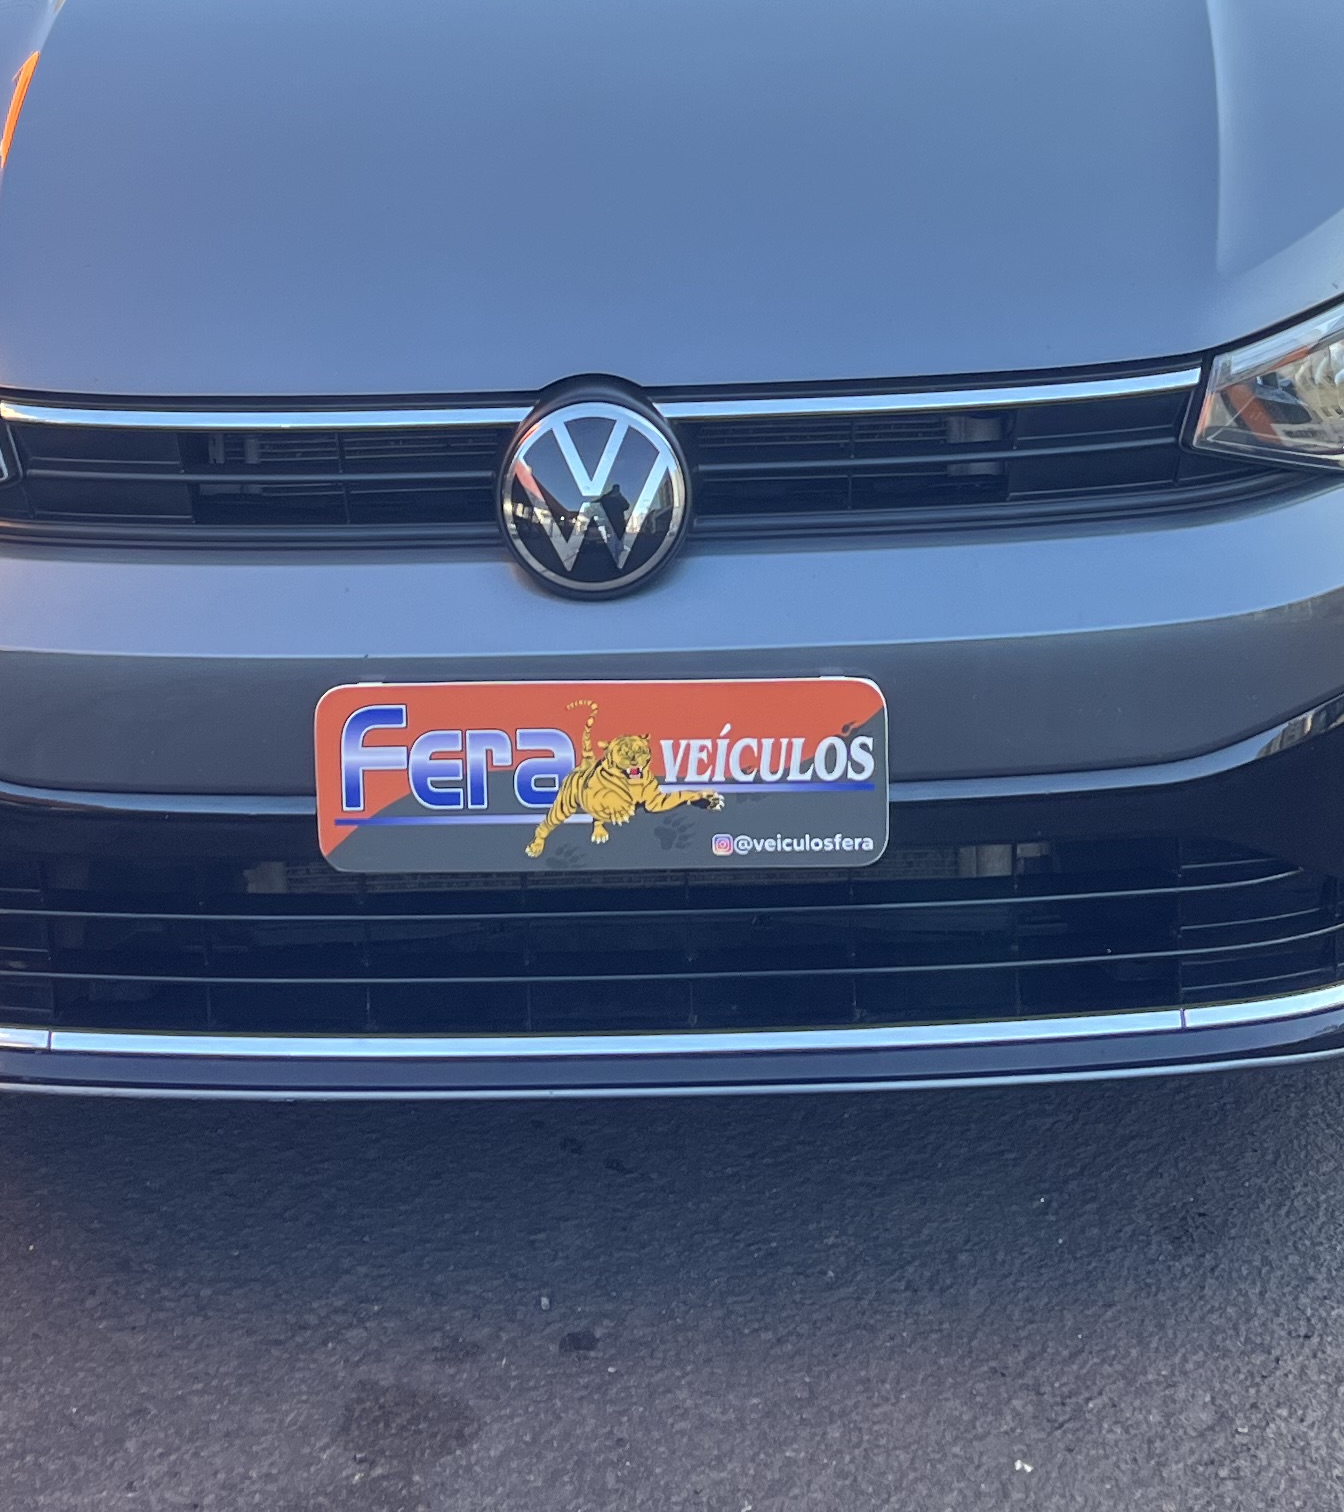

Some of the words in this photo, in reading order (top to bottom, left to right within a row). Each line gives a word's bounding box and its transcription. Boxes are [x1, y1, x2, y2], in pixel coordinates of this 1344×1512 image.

[339, 703, 576, 813] Fera
[659, 723, 875, 783] VEÍCULOS
[734, 833, 874, 856] @veiculosfera
